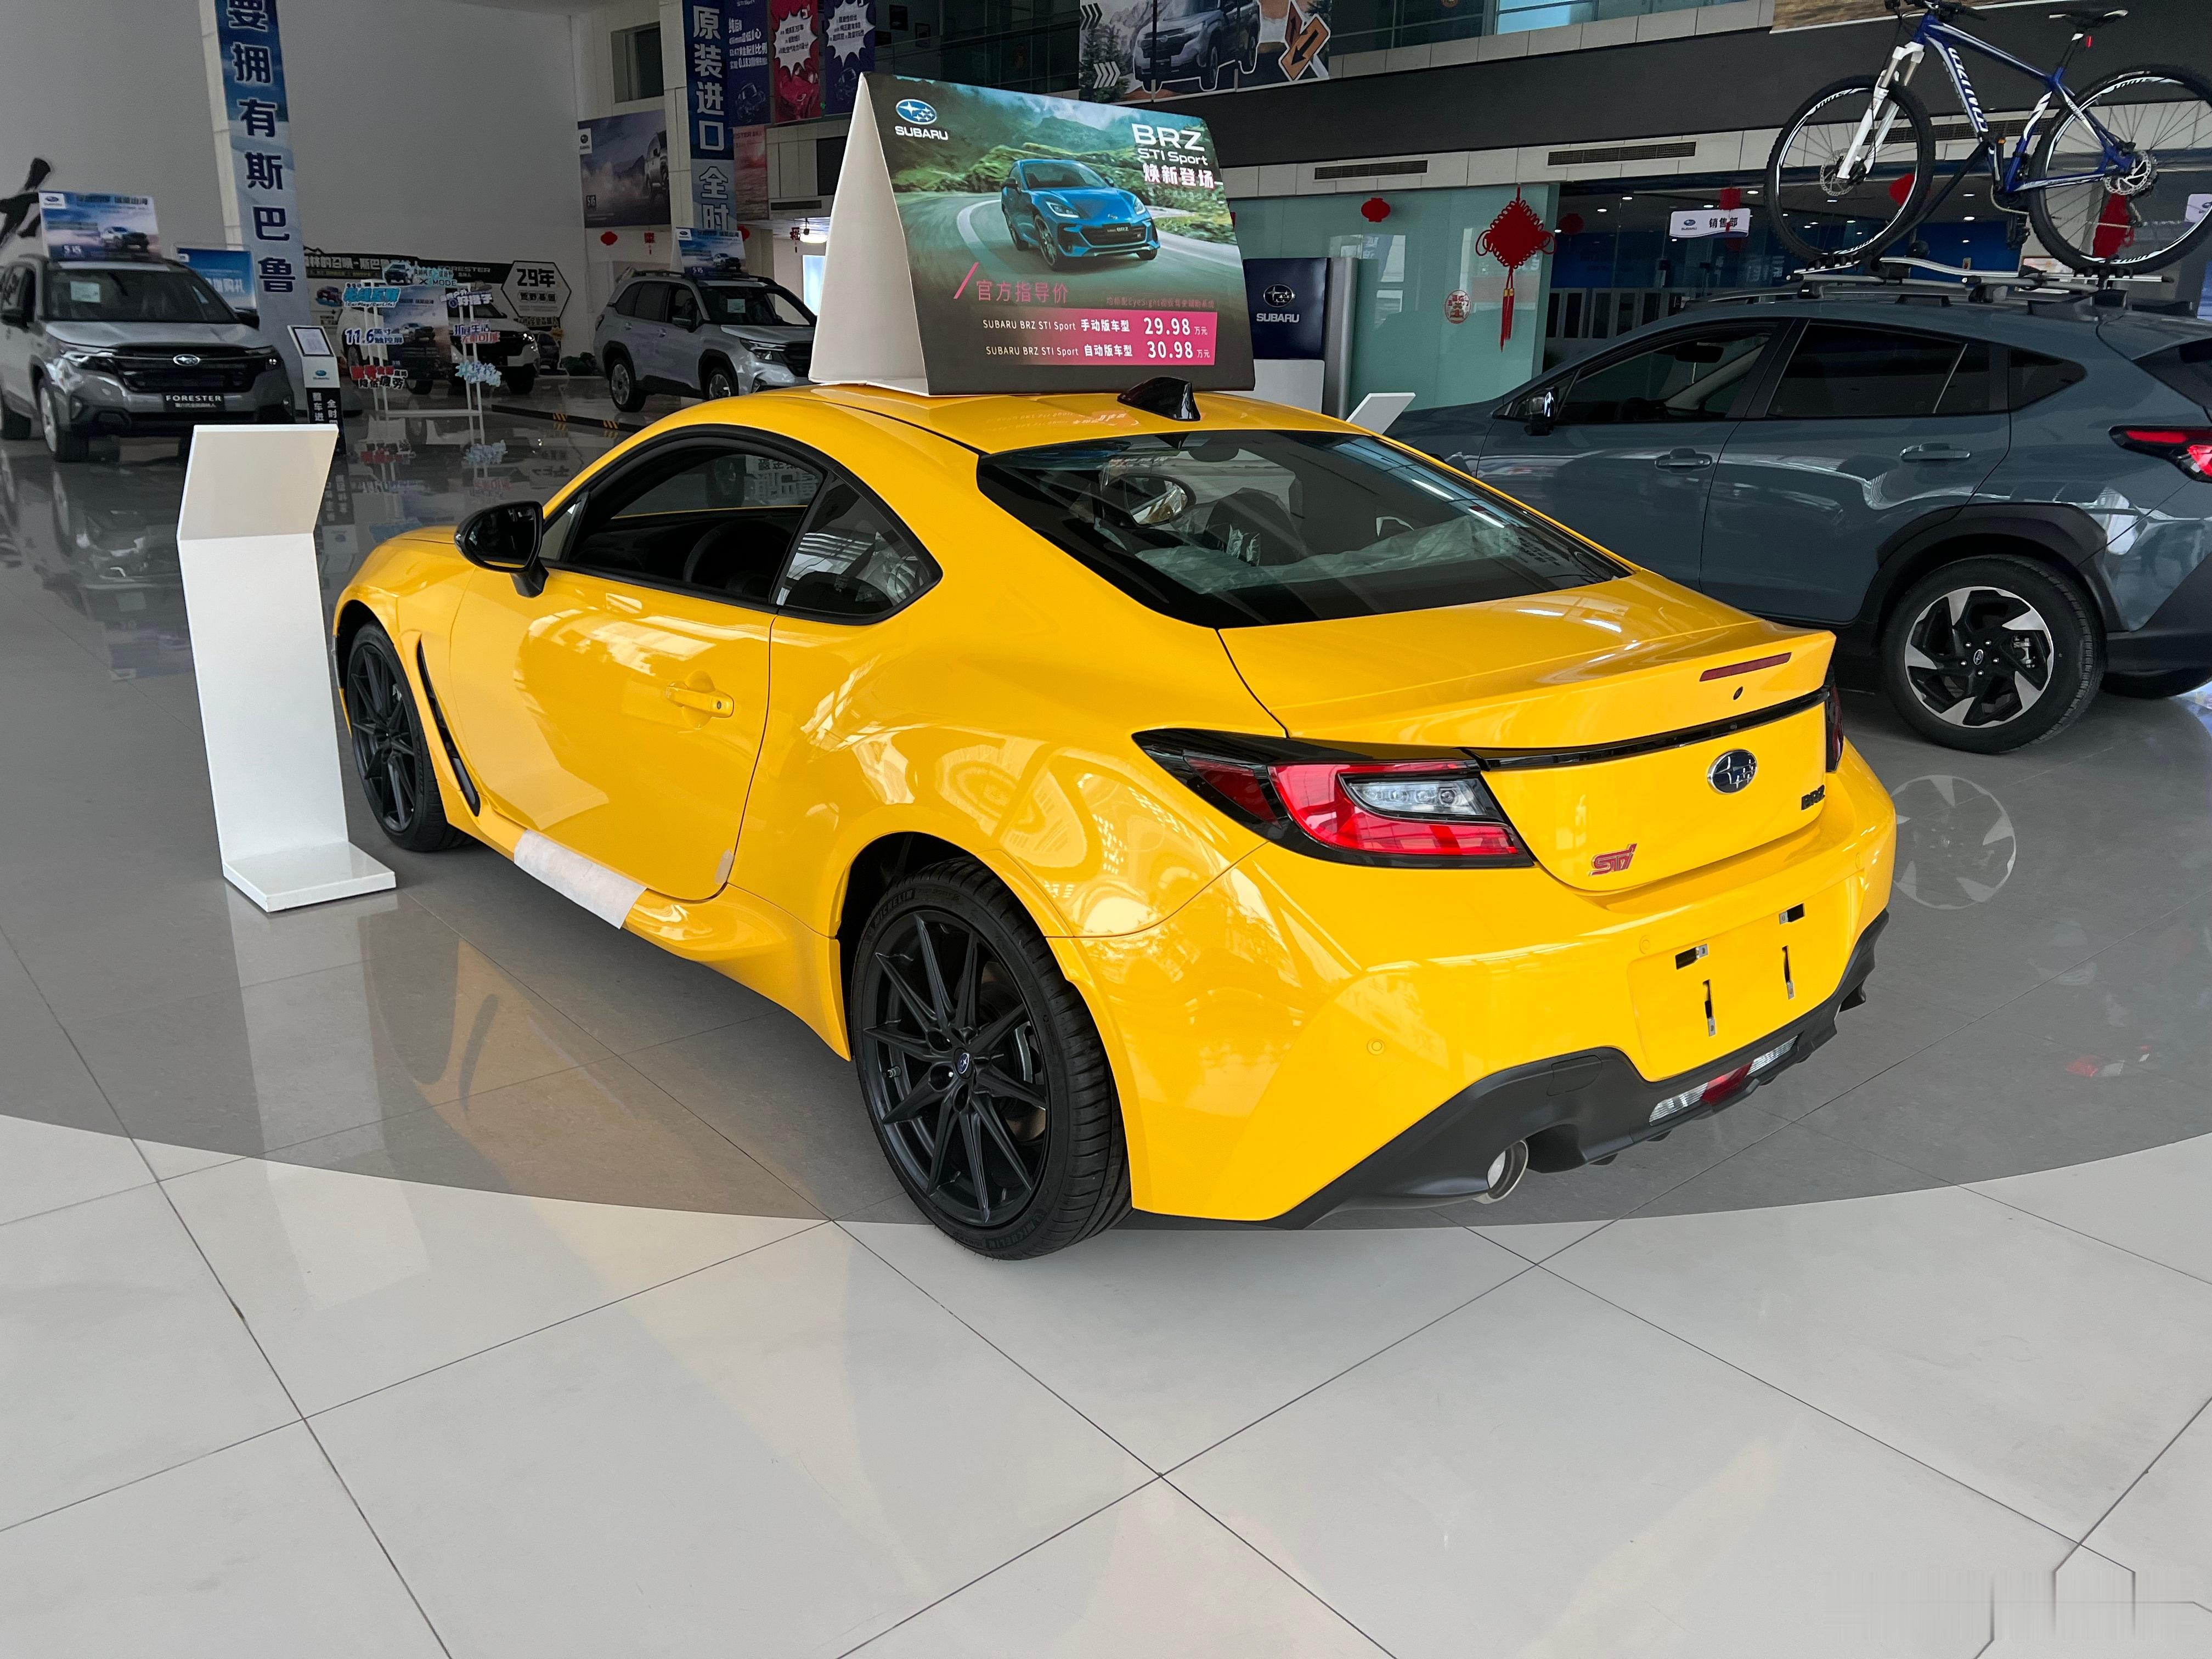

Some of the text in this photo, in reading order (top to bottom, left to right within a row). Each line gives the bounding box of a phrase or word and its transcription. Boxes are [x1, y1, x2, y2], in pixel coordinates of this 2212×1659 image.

[693, 5, 726, 151] 原装进口
[895, 125, 949, 141] SUBARU
[1132, 123, 1205, 151] BRZ
[1138, 148, 1208, 166] STI Sport
[1143, 163, 1215, 189] 焕新登场
[1709, 217, 1738, 228] 销售部
[516, 268, 555, 288] 29年
[977, 279, 1068, 304] 官方指导价
[983, 317, 1208, 335] SUBARU BRZ STI Sport 手动版车型 29.98 万元
[1256, 313, 1300, 323] SUBARU
[346, 329, 374, 343] 11.6
[986, 341, 1210, 358] SUBARU BRZ STI Sport 自动版车型 30.98 万元
[1801, 784, 1826, 811] BRZ
